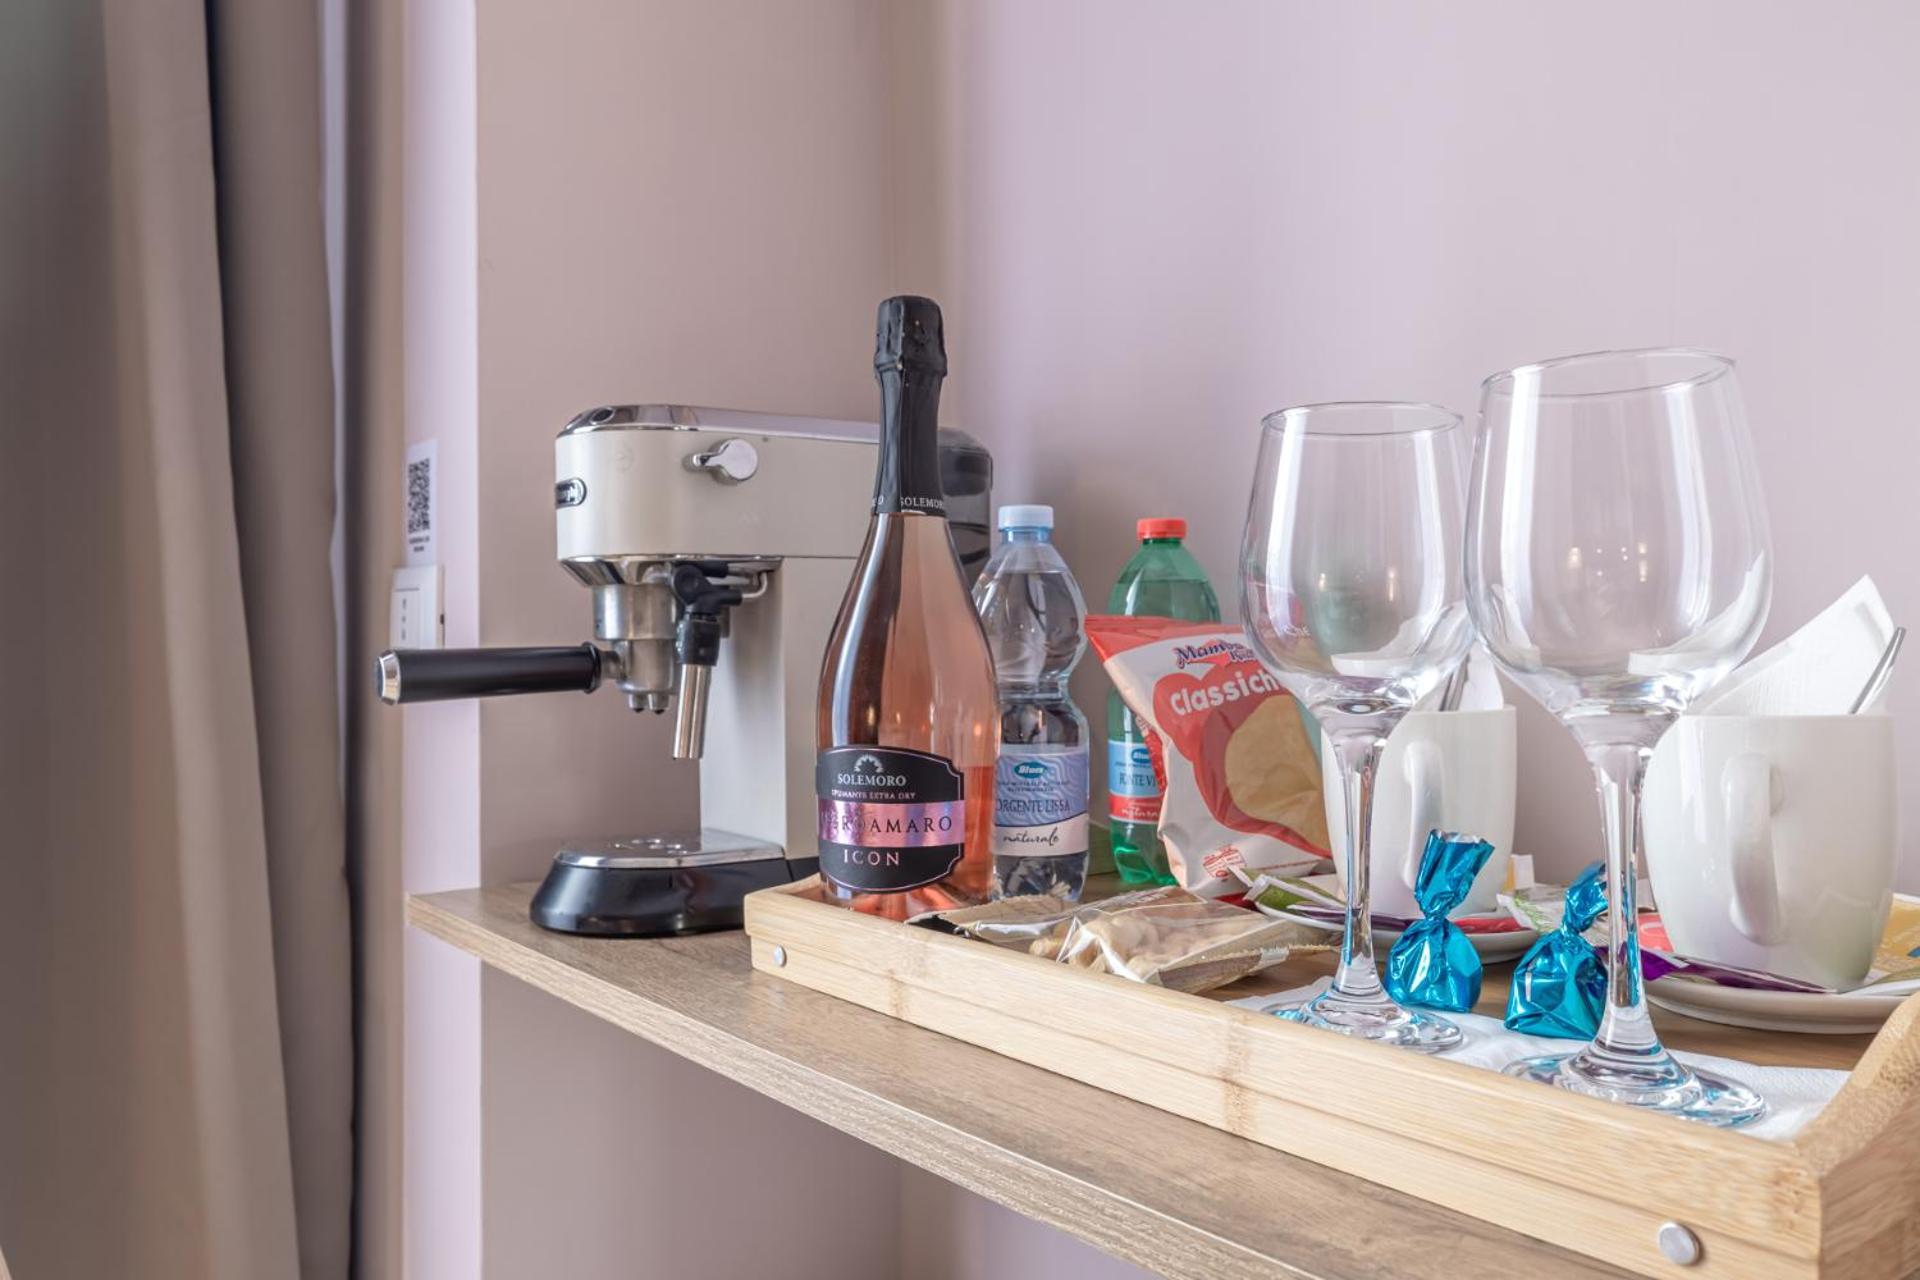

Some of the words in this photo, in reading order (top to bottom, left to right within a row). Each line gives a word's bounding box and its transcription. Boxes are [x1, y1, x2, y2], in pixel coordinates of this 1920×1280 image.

[1170, 669, 1280, 716] Classich
[838, 773, 906, 786] SOLEMORO
[898, 791, 916, 799] DRY
[844, 849, 900, 866] ICON
